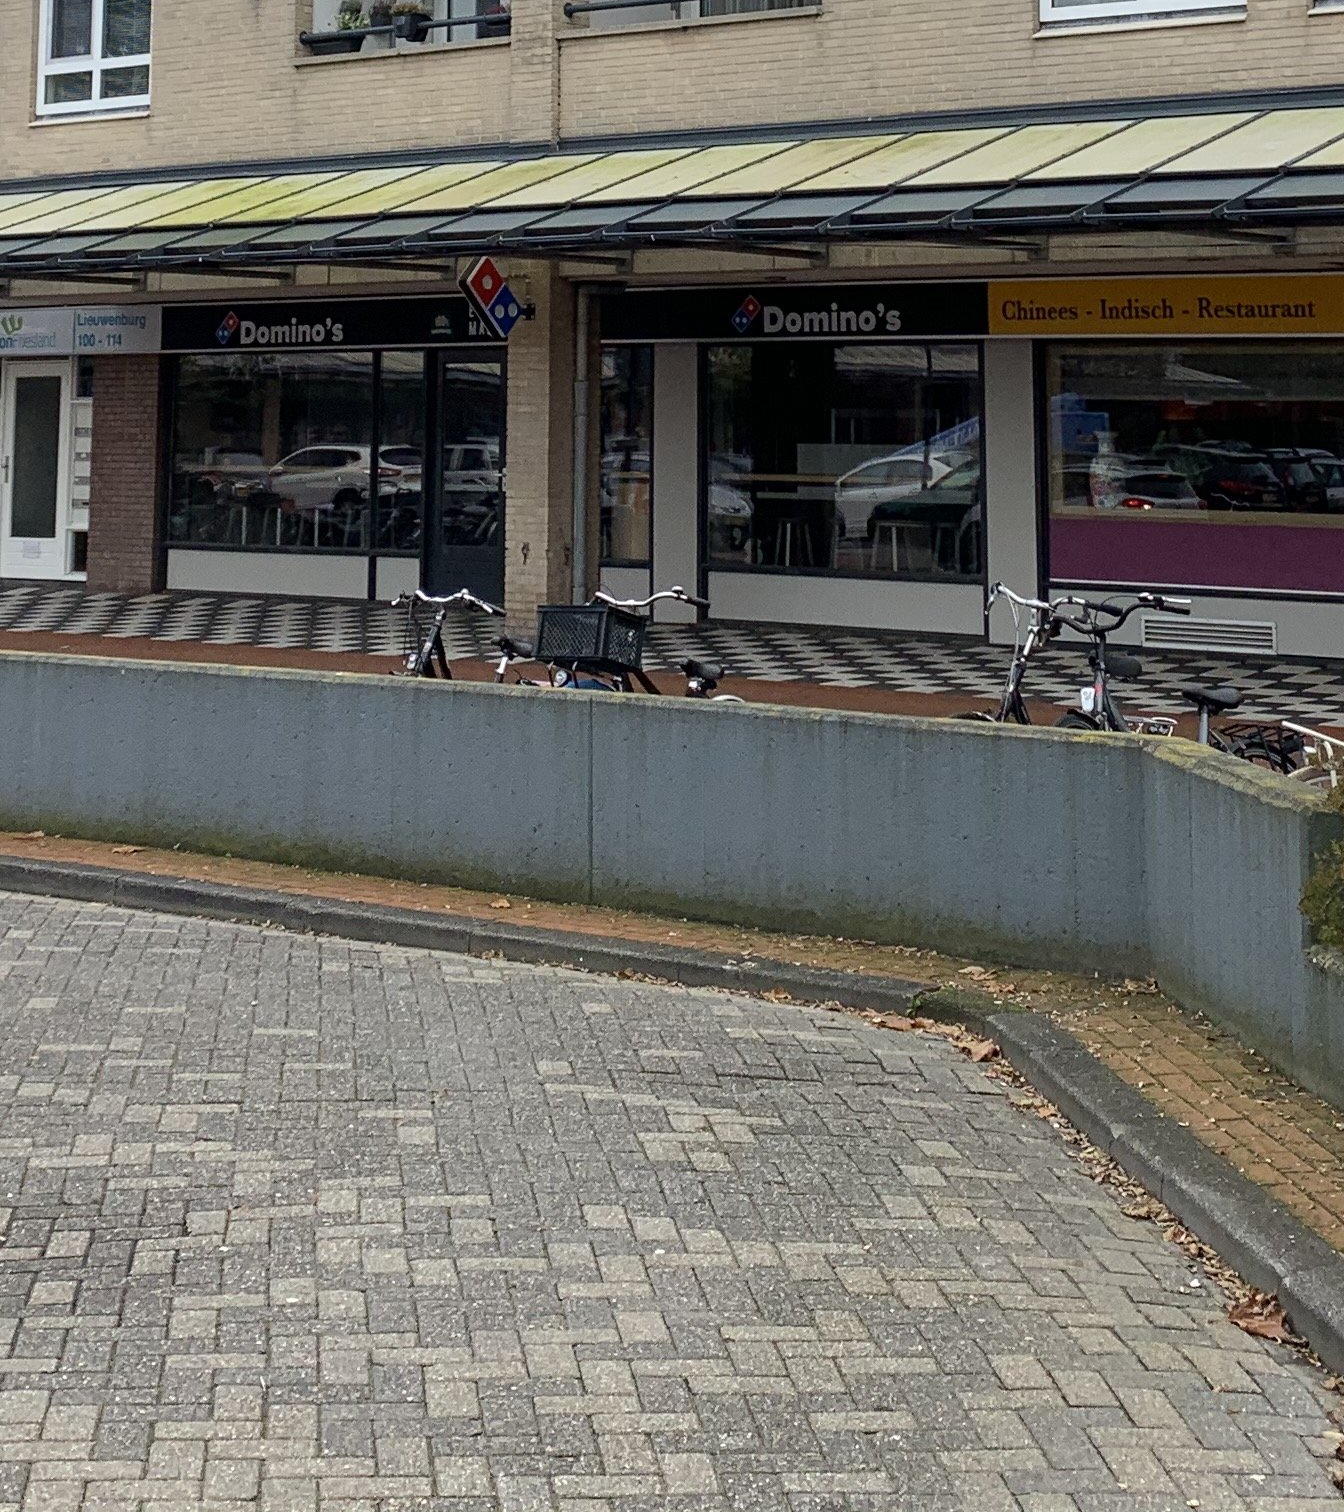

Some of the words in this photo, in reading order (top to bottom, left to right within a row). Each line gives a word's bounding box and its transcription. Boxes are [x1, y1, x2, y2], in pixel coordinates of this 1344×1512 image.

[763, 302, 902, 333] Domino's
[1001, 300, 1078, 320] Chinees
[1100, 298, 1174, 319] Indisch
[1196, 297, 1316, 319] Restaurant
[77, 313, 146, 329] Lieuwenburg
[240, 317, 344, 344] Domino's
[77, 333, 96, 347] 100
[106, 332, 122, 347] 114
